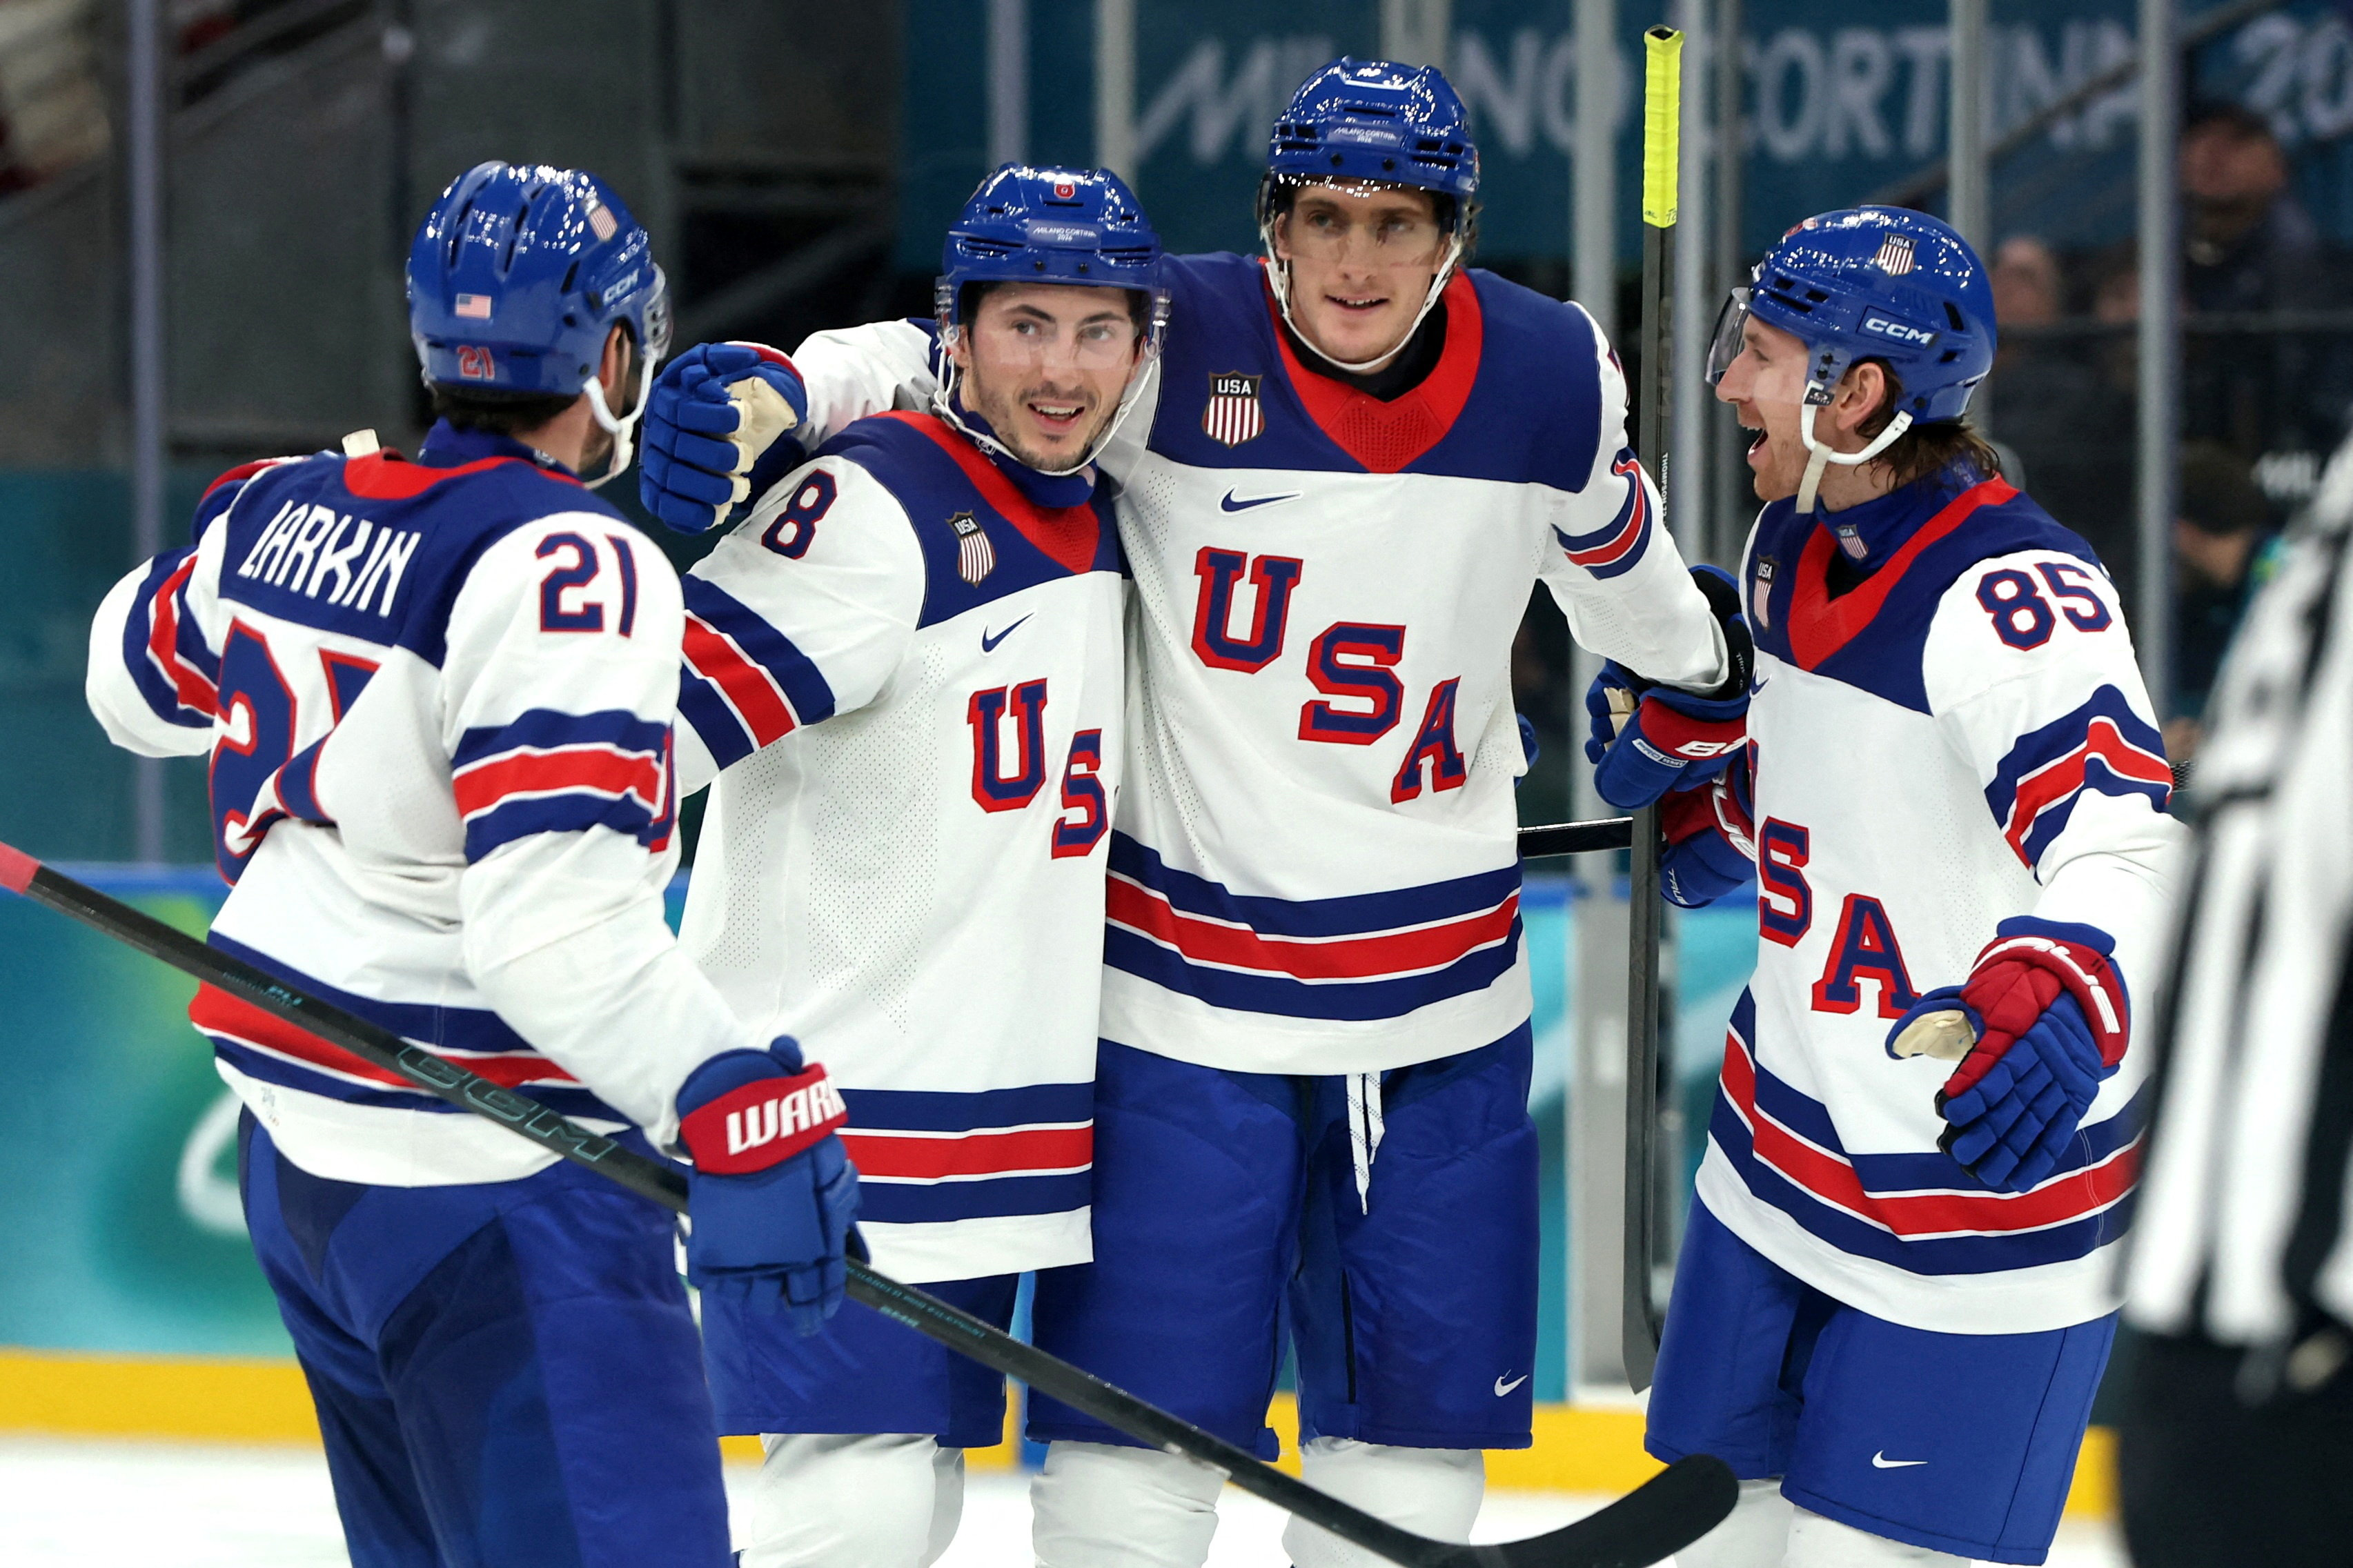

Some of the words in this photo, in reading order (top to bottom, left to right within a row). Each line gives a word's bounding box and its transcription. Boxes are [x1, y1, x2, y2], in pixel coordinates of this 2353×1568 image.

[1889, 235, 1911, 249] USA
[457, 345, 495, 381] 21
[1865, 317, 1933, 344] CCM
[1217, 379, 1252, 395] USA
[237, 499, 422, 618] LARKIN
[761, 468, 837, 561] 8
[954, 517, 978, 535] USA
[535, 530, 638, 638] 21
[1758, 562, 1773, 580] USA
[1976, 562, 2113, 651] 85
[1191, 545, 1467, 805] USA
[967, 677, 1119, 860] US
[1746, 737, 1922, 1020] SA
